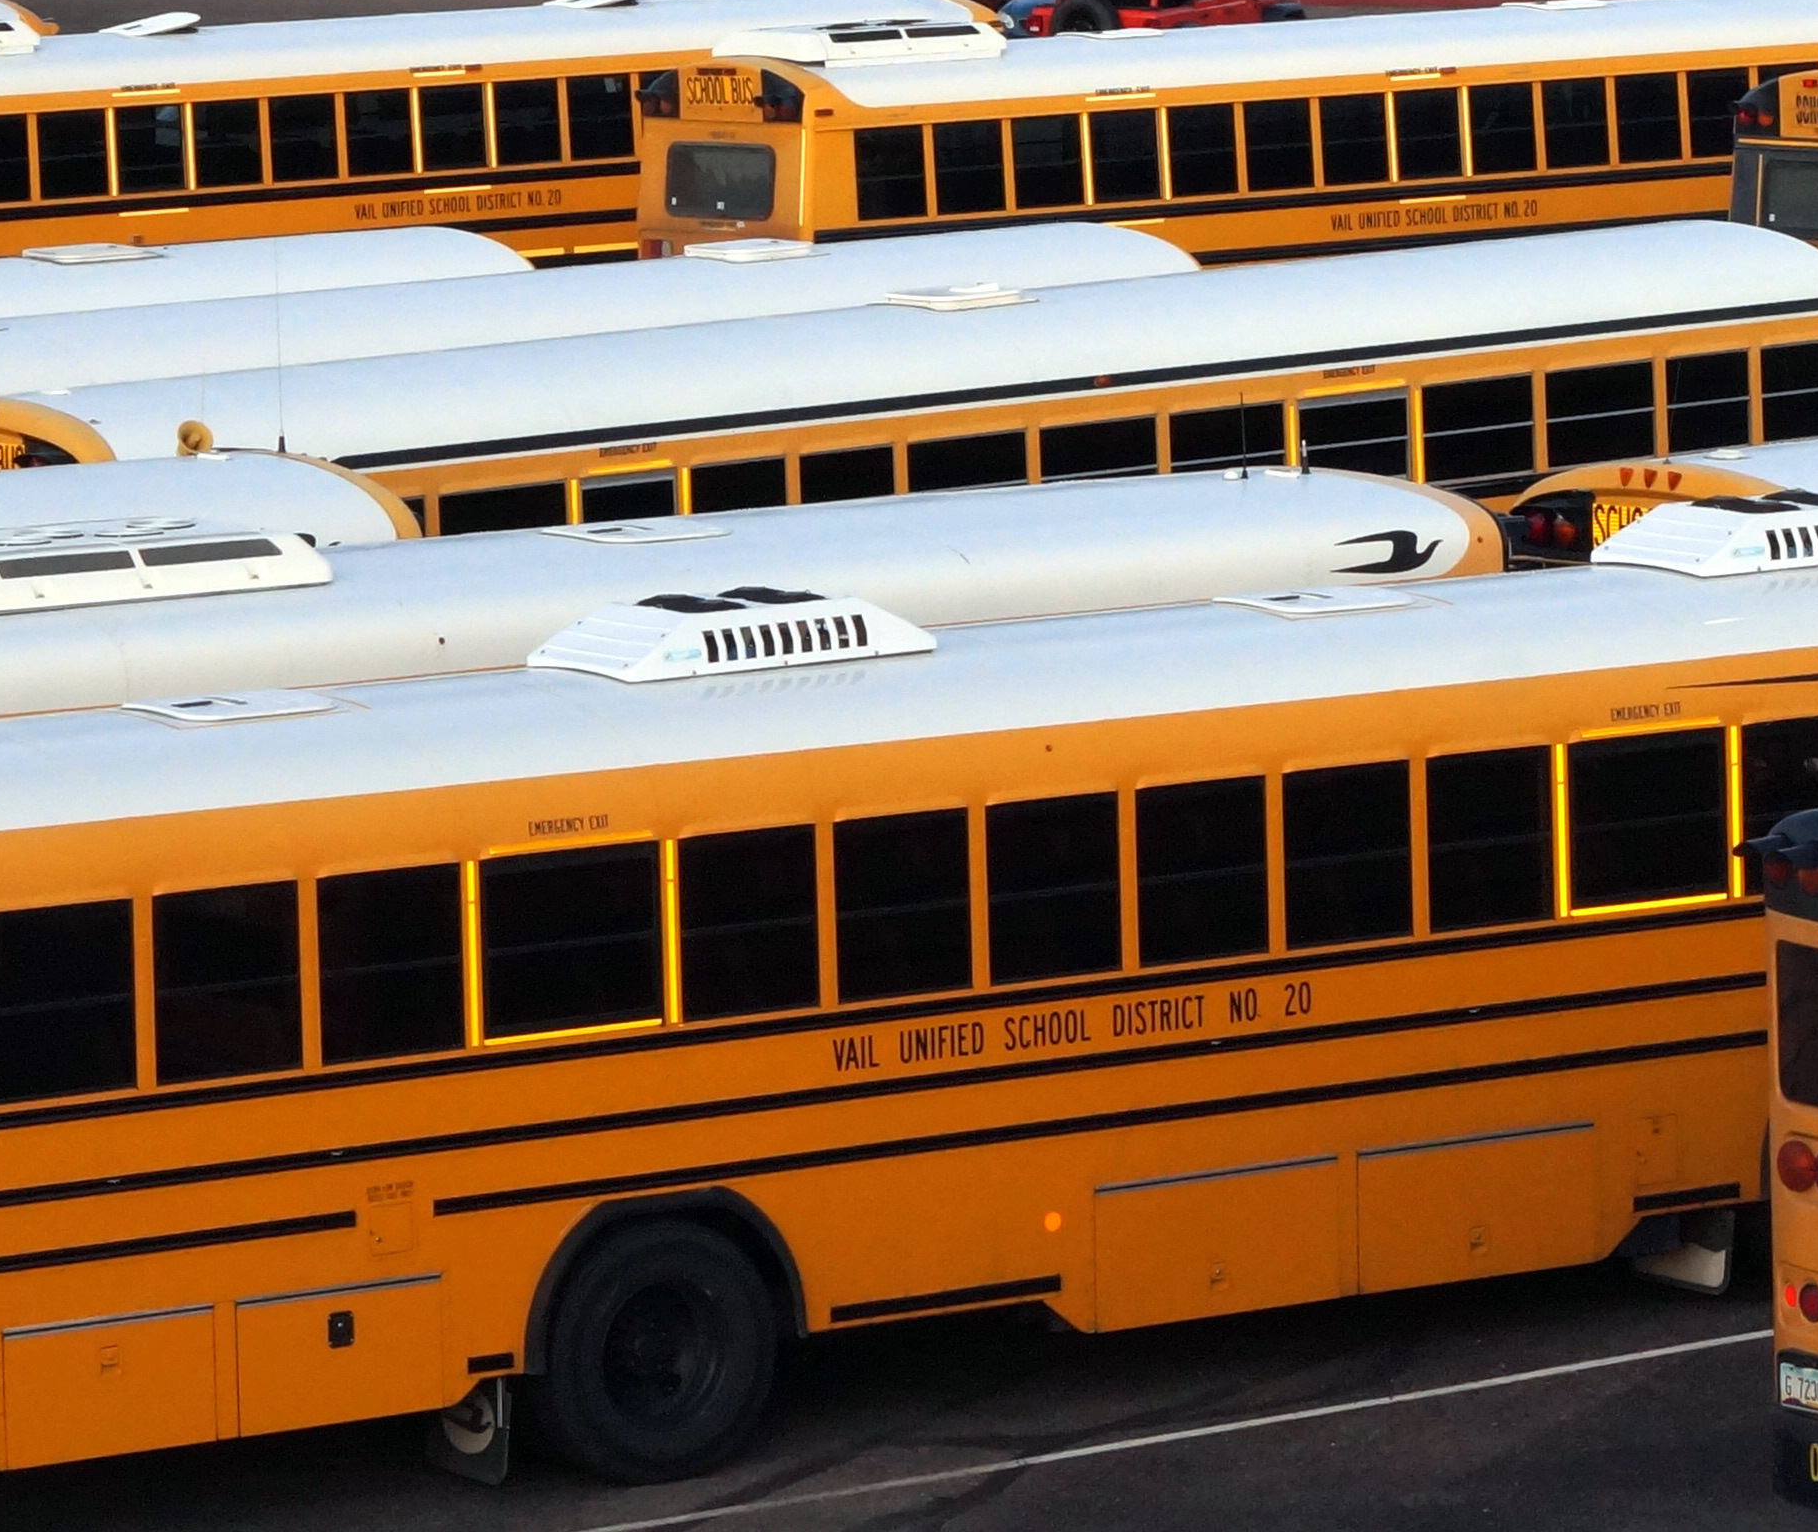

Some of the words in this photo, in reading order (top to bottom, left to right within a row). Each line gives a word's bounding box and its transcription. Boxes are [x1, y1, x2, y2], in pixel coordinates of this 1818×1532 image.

[686, 76, 729, 105] SCHOOL
[731, 77, 754, 105] BUS
[354, 203, 377, 220] VAIL
[382, 199, 424, 219] UNIFIED
[429, 195, 471, 216] SCHOOL
[476, 192, 522, 212] DISTRICT
[547, 189, 562, 206] 20
[1330, 215, 1353, 231] VAIL
[1358, 210, 1400, 230] UNIFIED
[1406, 206, 1447, 226] SCHOOL
[1453, 203, 1499, 222] DISTRICT
[1524, 200, 1538, 217] 20
[1610, 705, 1660, 722] EMERGENCY
[1663, 701, 1682, 716] EXIT
[527, 817, 585, 837] EMERGENCY
[588, 813, 610, 832] EXIT
[832, 1035, 881, 1072] VAIL
[899, 1021, 985, 1064] UNIFIED
[1004, 1008, 1092, 1053] SCHOOL
[1112, 995, 1205, 1038] DISTRICT
[1284, 980, 1312, 1018] 20
[1784, 1375, 1792, 1397] G
